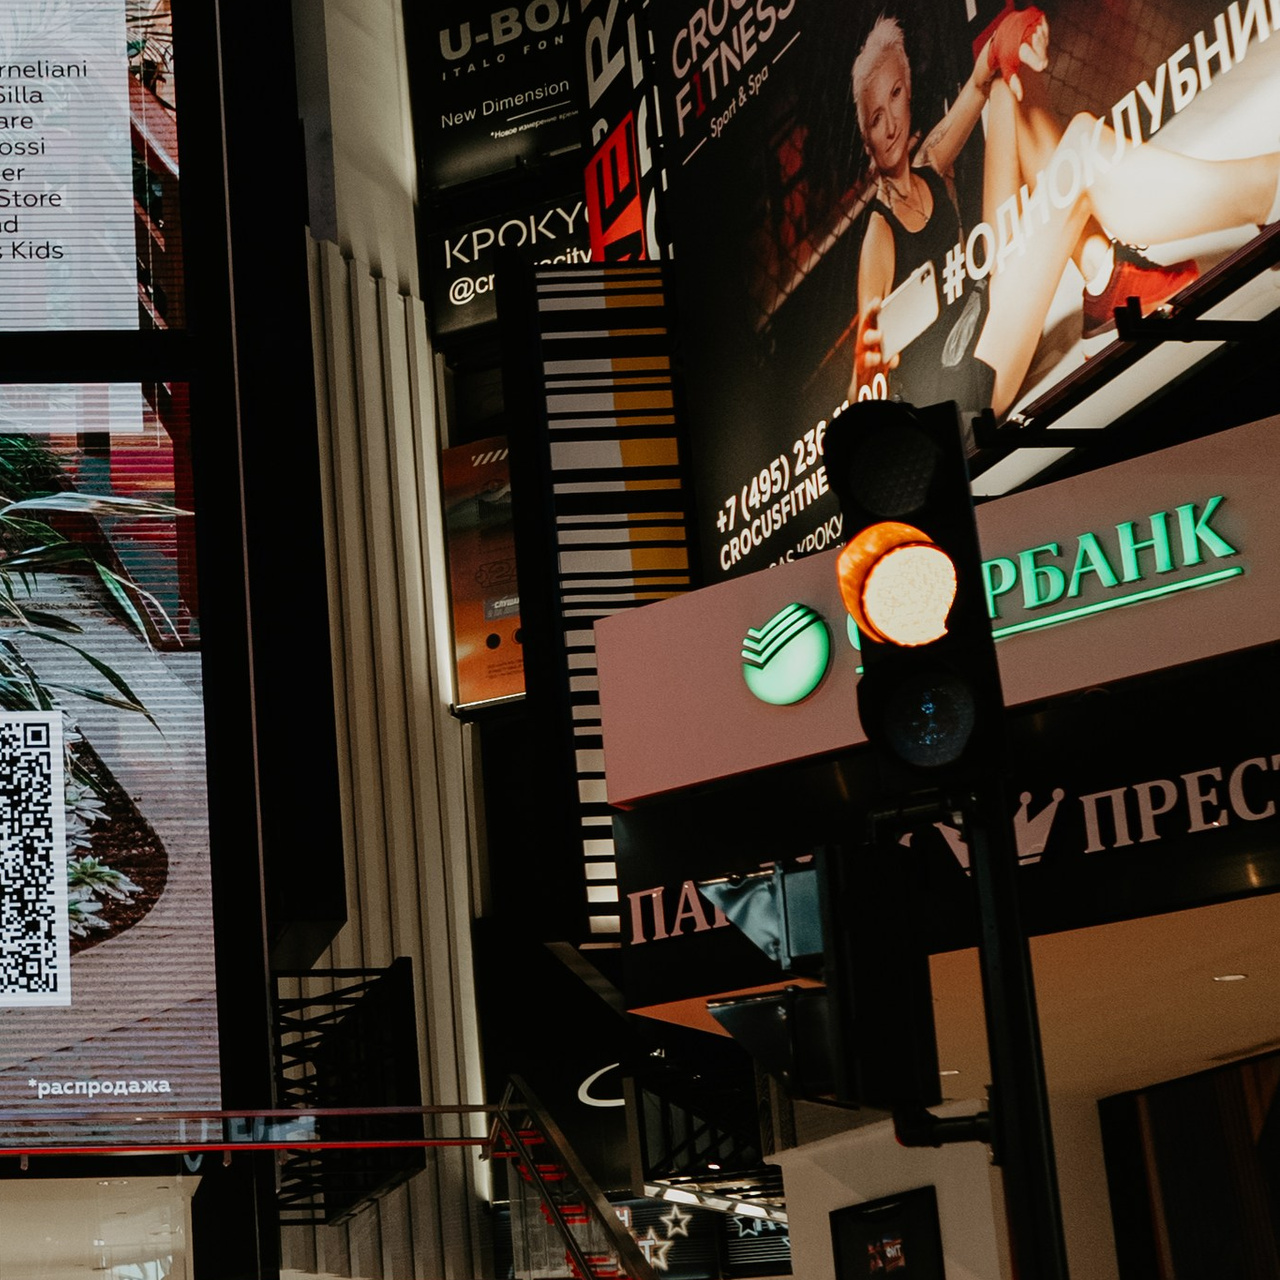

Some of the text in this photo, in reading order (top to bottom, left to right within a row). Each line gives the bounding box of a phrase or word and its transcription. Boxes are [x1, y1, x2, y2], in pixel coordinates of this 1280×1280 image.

[440, 33, 565, 82] ITALO FON
[440, 78, 571, 130] New Dimension
[710, 100, 738, 138] Sport
[748, 64, 769, 96] Spa
[10, 239, 65, 261] Kids
[445, 200, 589, 269] КРОКУ
[716, 495, 738, 533] +7
[740, 454, 791, 522] (495)
[719, 465, 830, 571] CROCUSFITNE
[796, 511, 844, 554] КРОКУ
